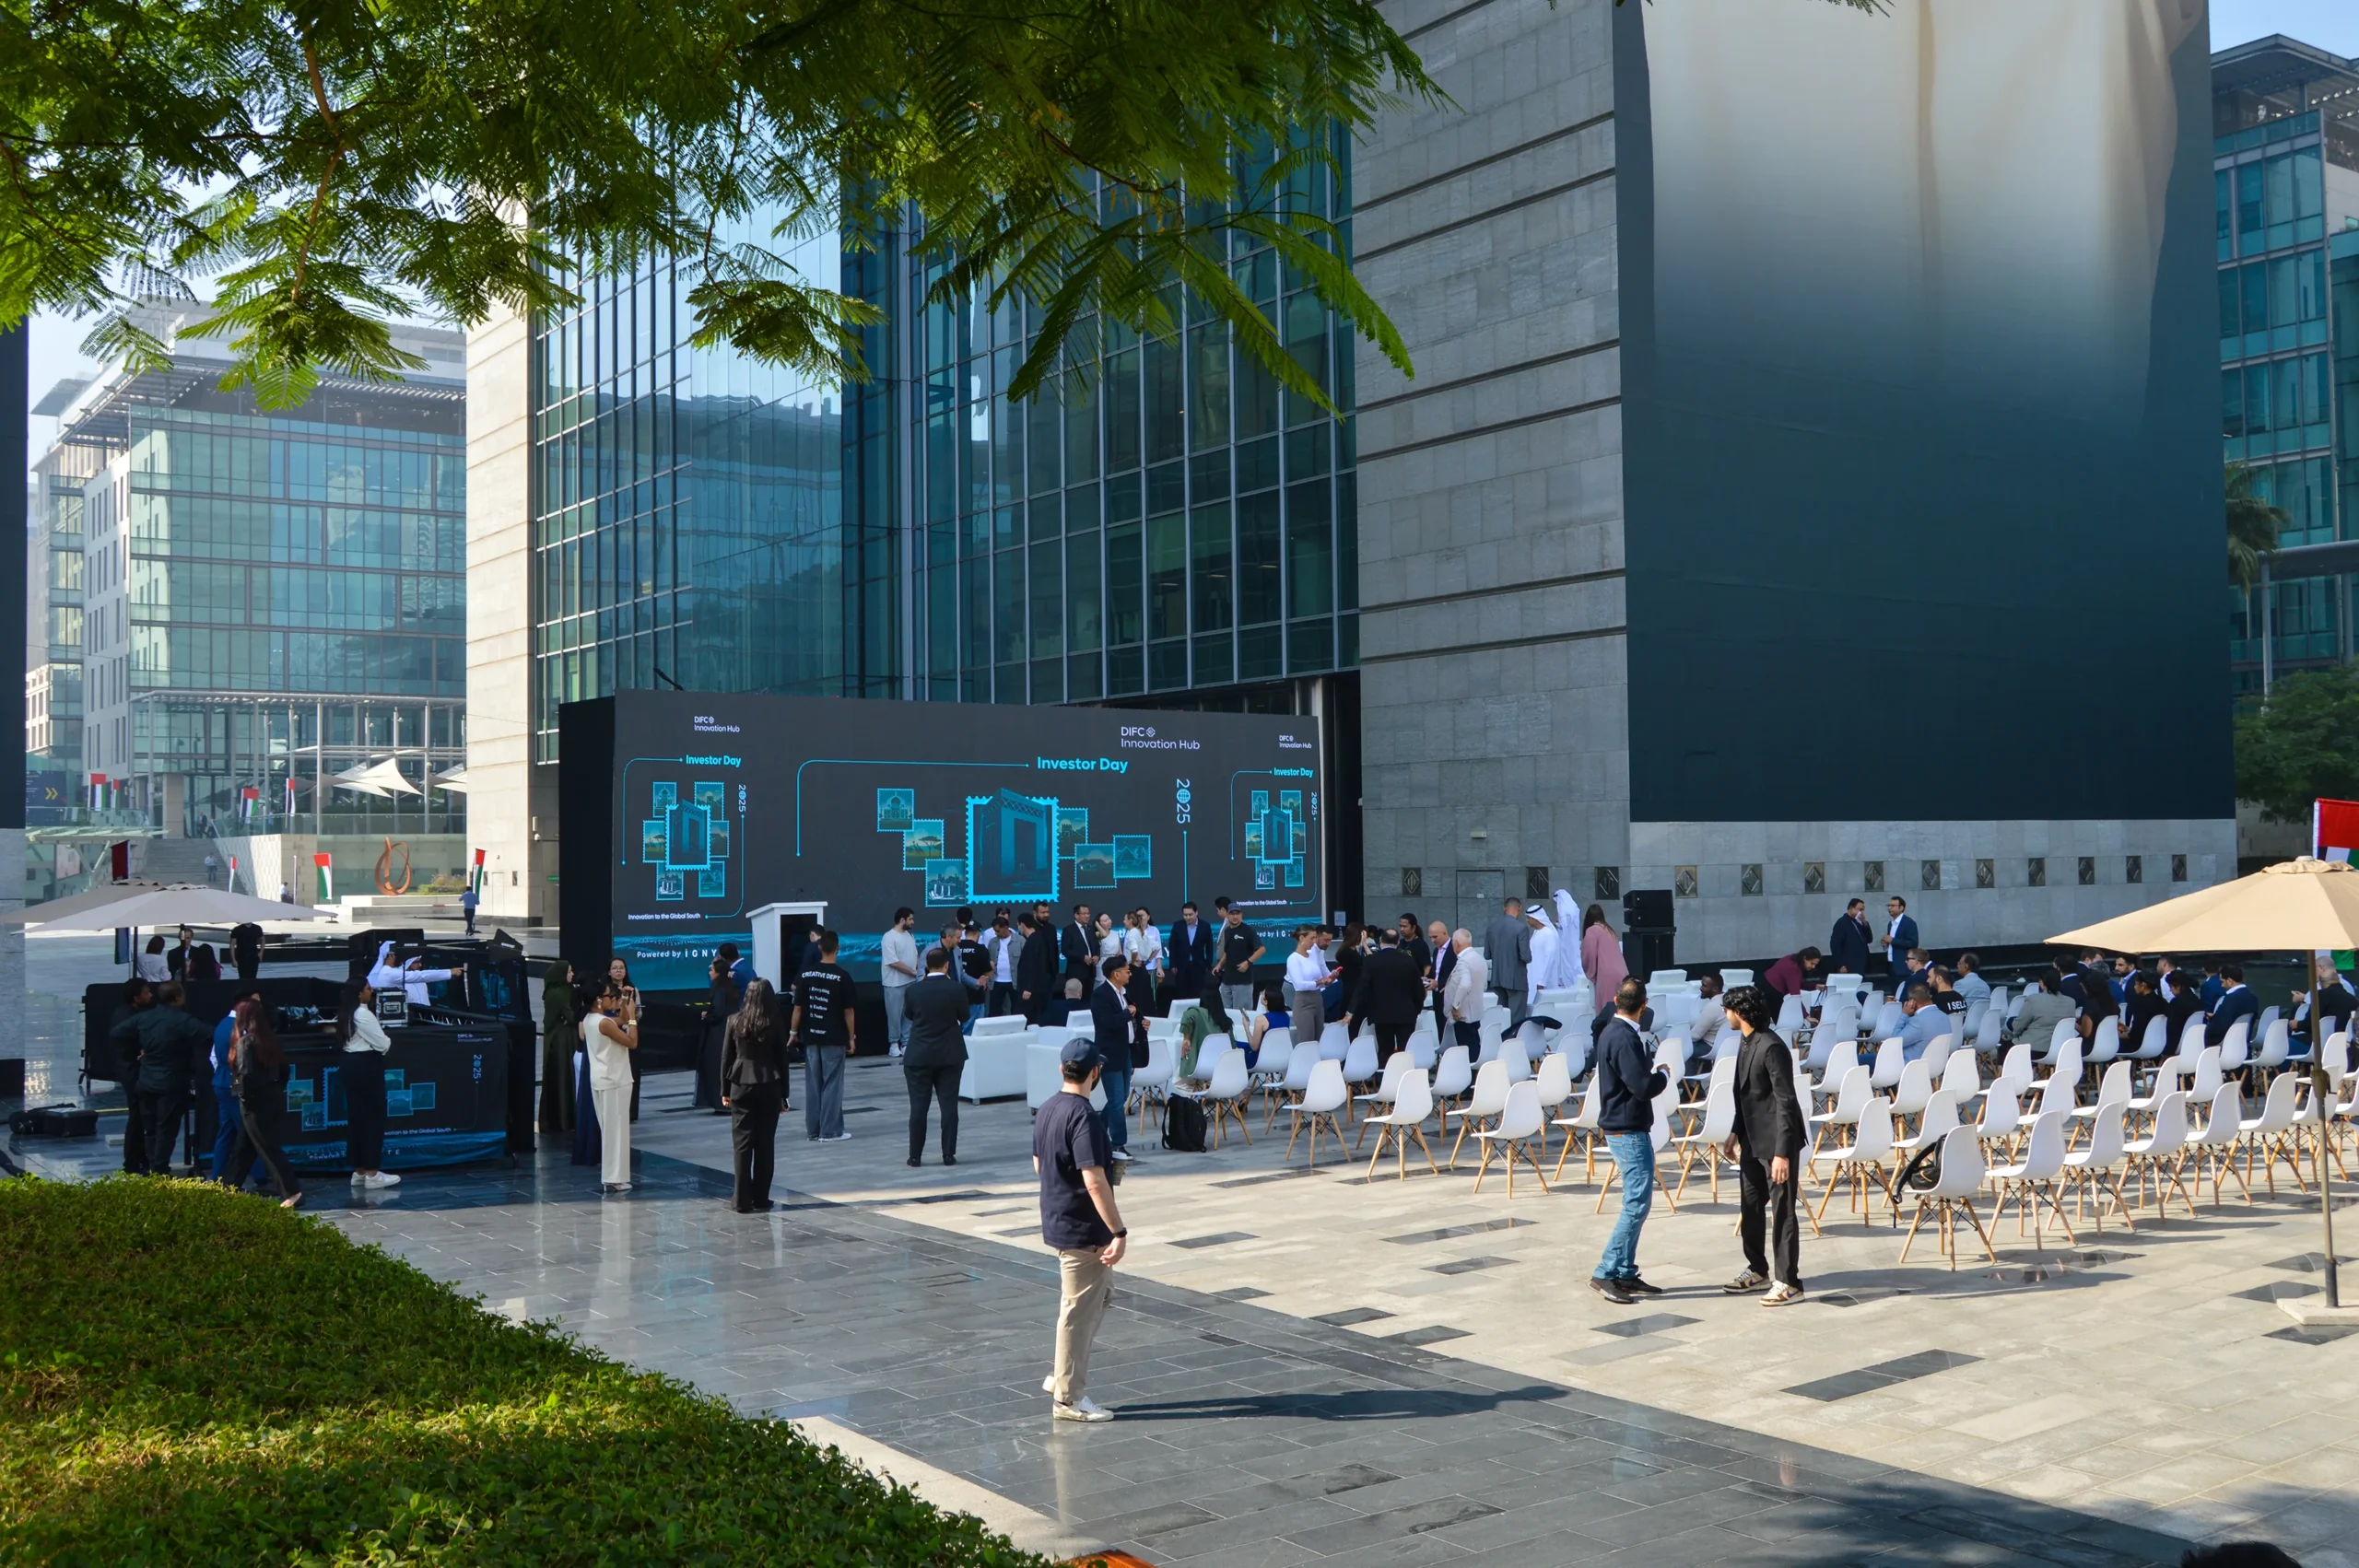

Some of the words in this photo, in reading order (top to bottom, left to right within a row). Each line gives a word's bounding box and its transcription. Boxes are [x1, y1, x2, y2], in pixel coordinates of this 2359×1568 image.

[1121, 726, 1145, 737] DIFC
[1121, 738, 1177, 749] Innovation
[1179, 740, 1200, 749] Hub
[686, 755, 722, 765] Investor
[723, 755, 742, 767] Day
[1037, 756, 1097, 770] Investor
[1099, 758, 1129, 774] Day
[1273, 767, 1299, 776] Investor
[1300, 767, 1313, 778] Day
[738, 784, 746, 813] 2025
[1176, 778, 1191, 824] 2025
[637, 950, 670, 958] Powered
[672, 950, 681, 959] by
[826, 973, 840, 981] DEPT.
